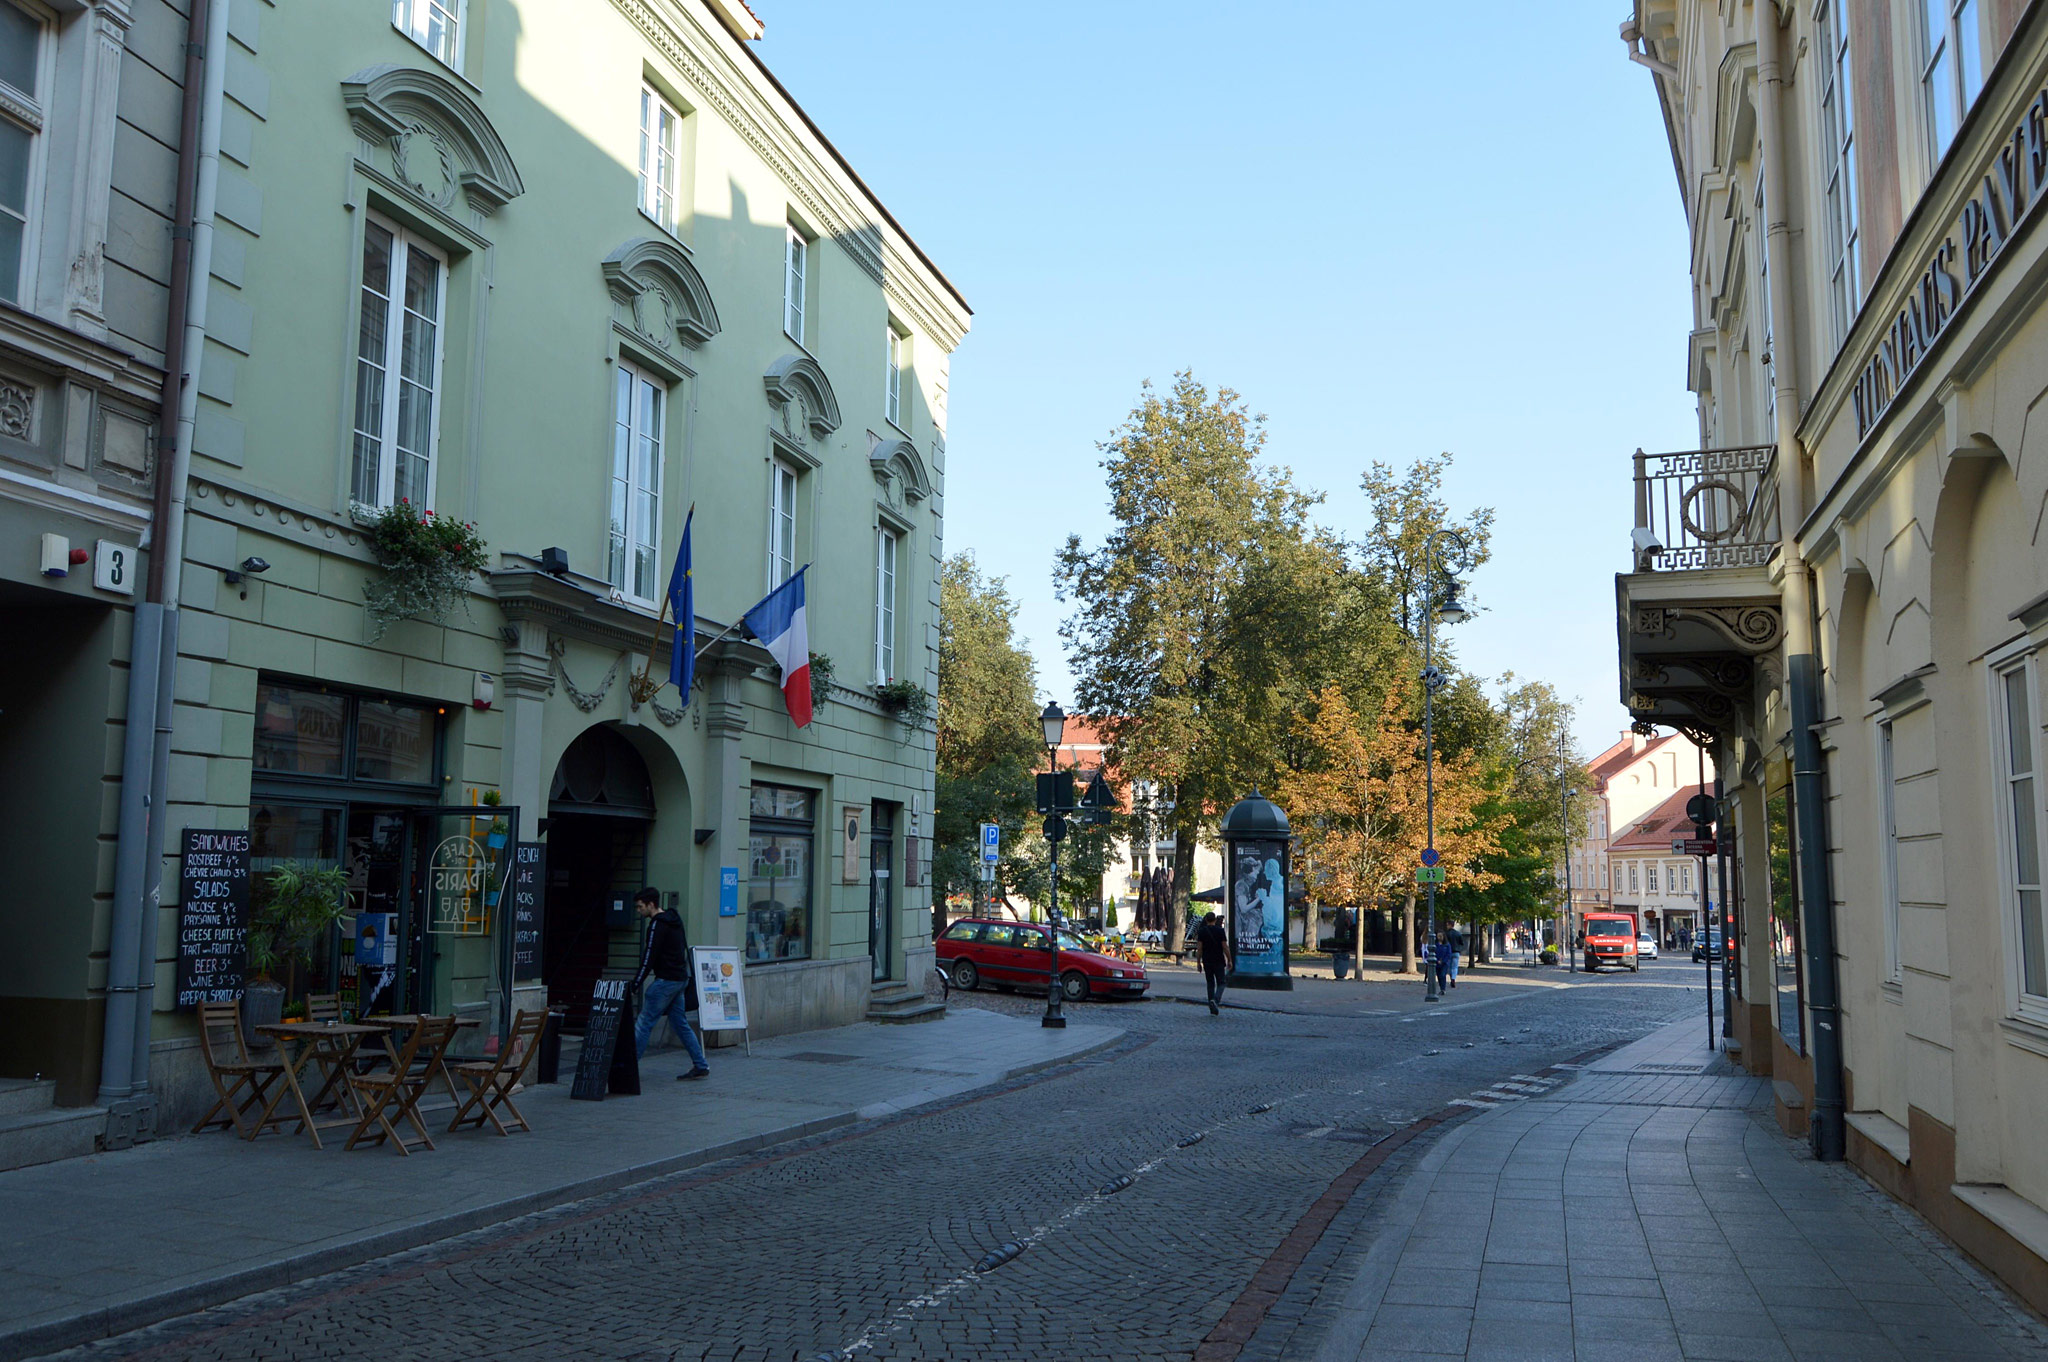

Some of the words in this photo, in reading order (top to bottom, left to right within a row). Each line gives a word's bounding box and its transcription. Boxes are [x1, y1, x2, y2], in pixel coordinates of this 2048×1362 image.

[1850, 236, 1958, 444] VILNIAUS
[111, 550, 123, 585] 3
[191, 833, 249, 852] SANDWICHES
[988, 828, 997, 844] P
[187, 853, 223, 866] ROSTBEEF
[517, 846, 540, 863] RENCH
[209, 867, 232, 878] CHAUD
[193, 880, 231, 899] SALADS
[187, 901, 217, 913] NICOISE
[183, 914, 222, 926] PAYSANNE
[182, 928, 213, 943] CHEESE
[214, 928, 235, 941] PLATE
[181, 943, 201, 956] TART
[211, 943, 232, 955] FRUIT
[513, 950, 533, 965] OFFEE
[194, 957, 217, 974] BEER
[188, 974, 214, 988] WINE
[179, 990, 207, 1006] APEROL
[210, 988, 234, 1004] SPRITZ
[592, 978, 611, 1000] COME
[606, 979, 629, 1001] INSIDE
[590, 1015, 615, 1030] COFFEE
[588, 1030, 608, 1047] FOOD
[584, 1048, 605, 1063] BEER
